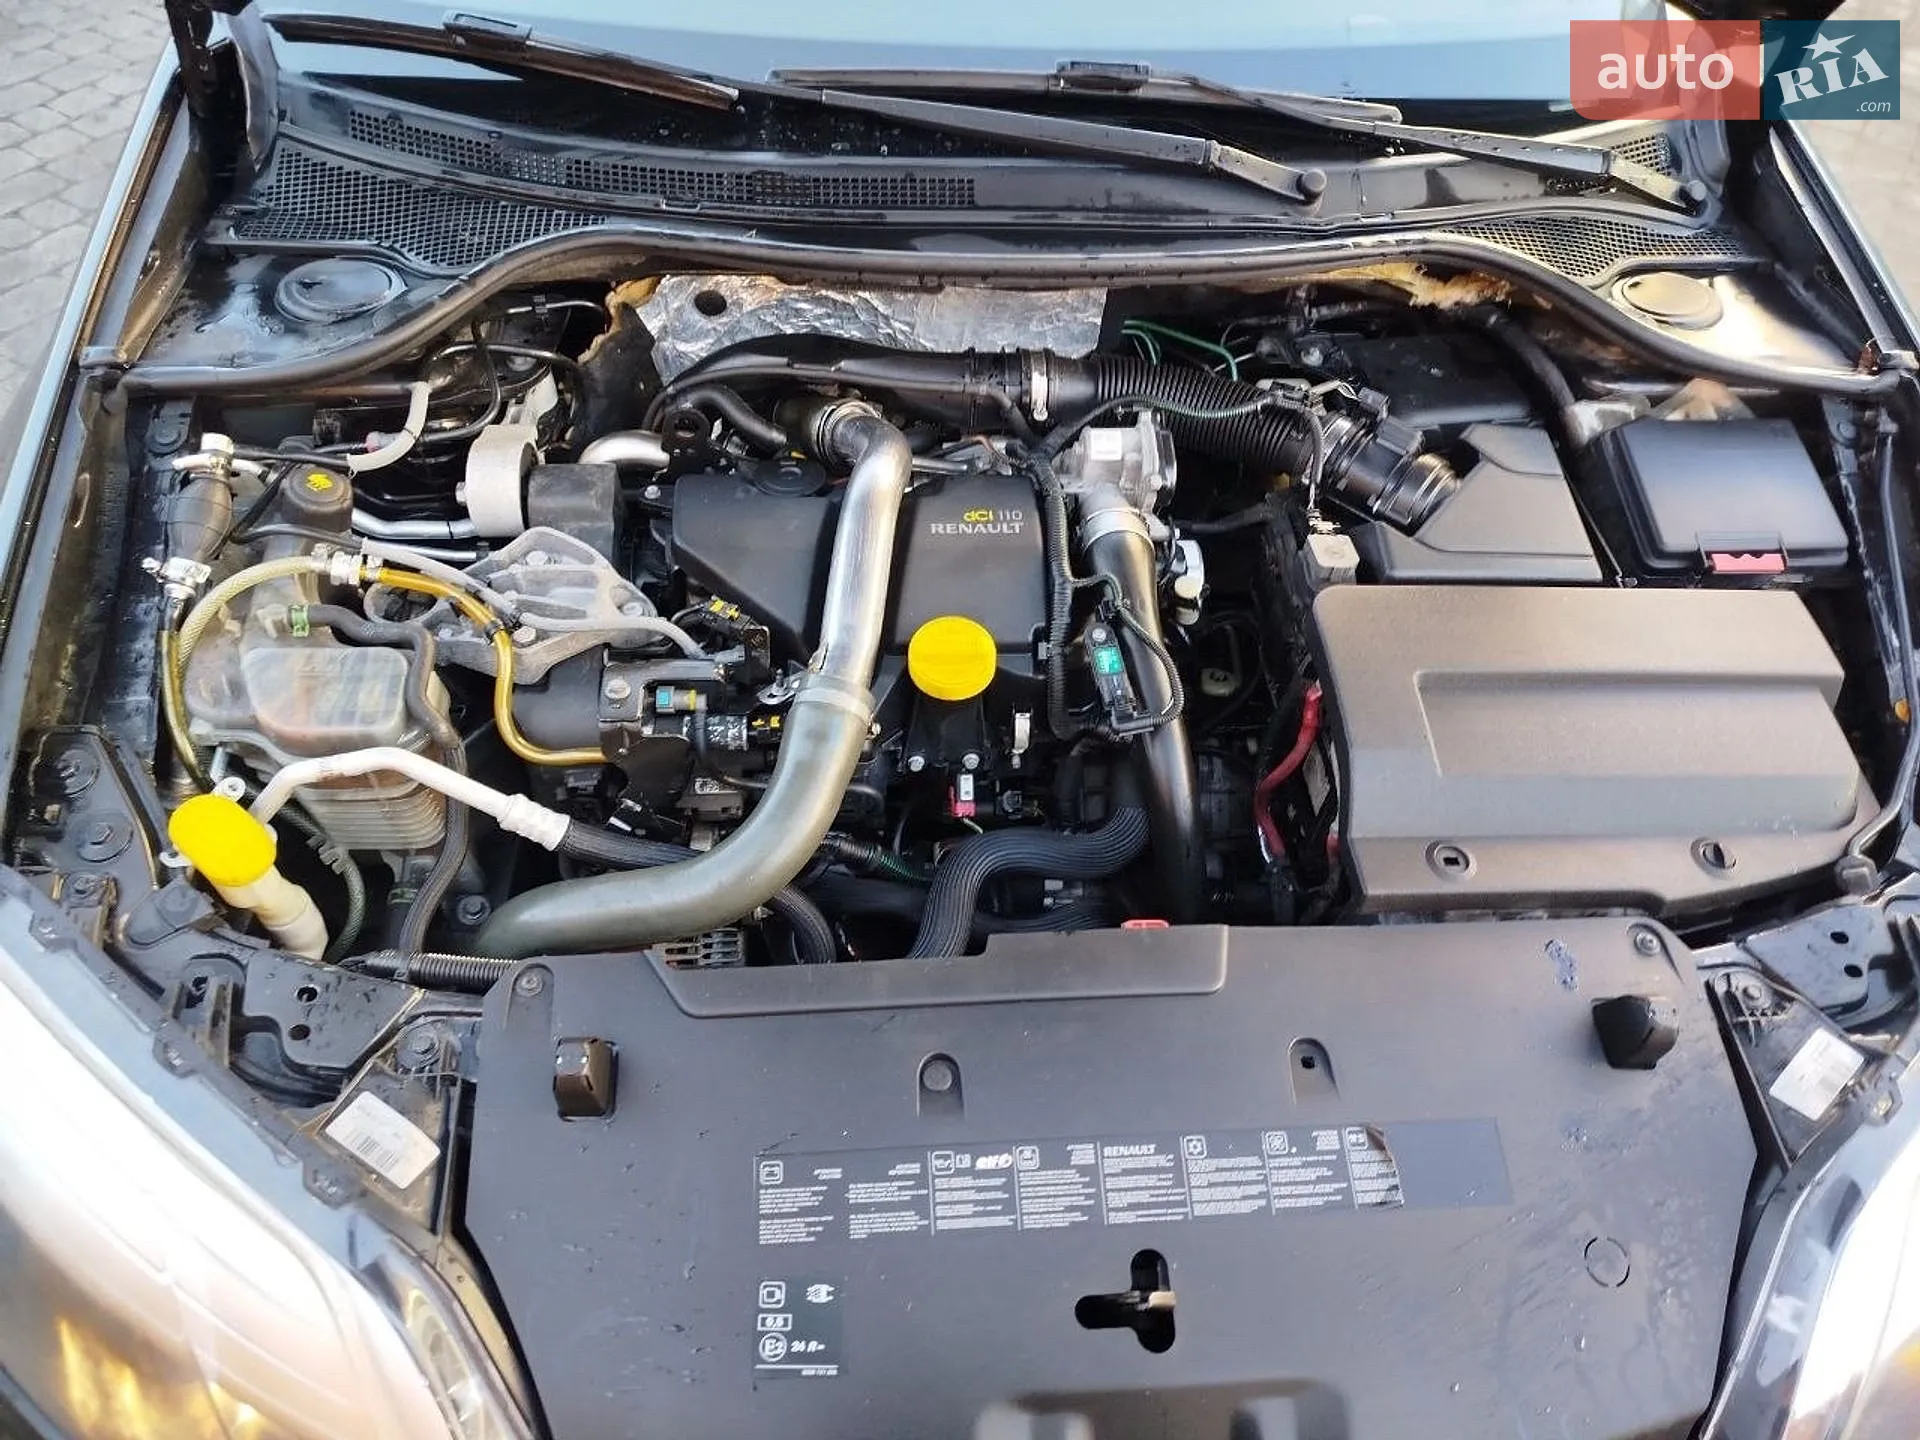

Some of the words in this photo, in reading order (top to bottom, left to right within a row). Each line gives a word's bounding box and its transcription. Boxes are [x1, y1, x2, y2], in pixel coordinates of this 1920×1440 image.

[999, 509, 1023, 521] 110
[930, 523, 1023, 535] RENAULT
[1103, 1144, 1156, 1158] RENAULT
